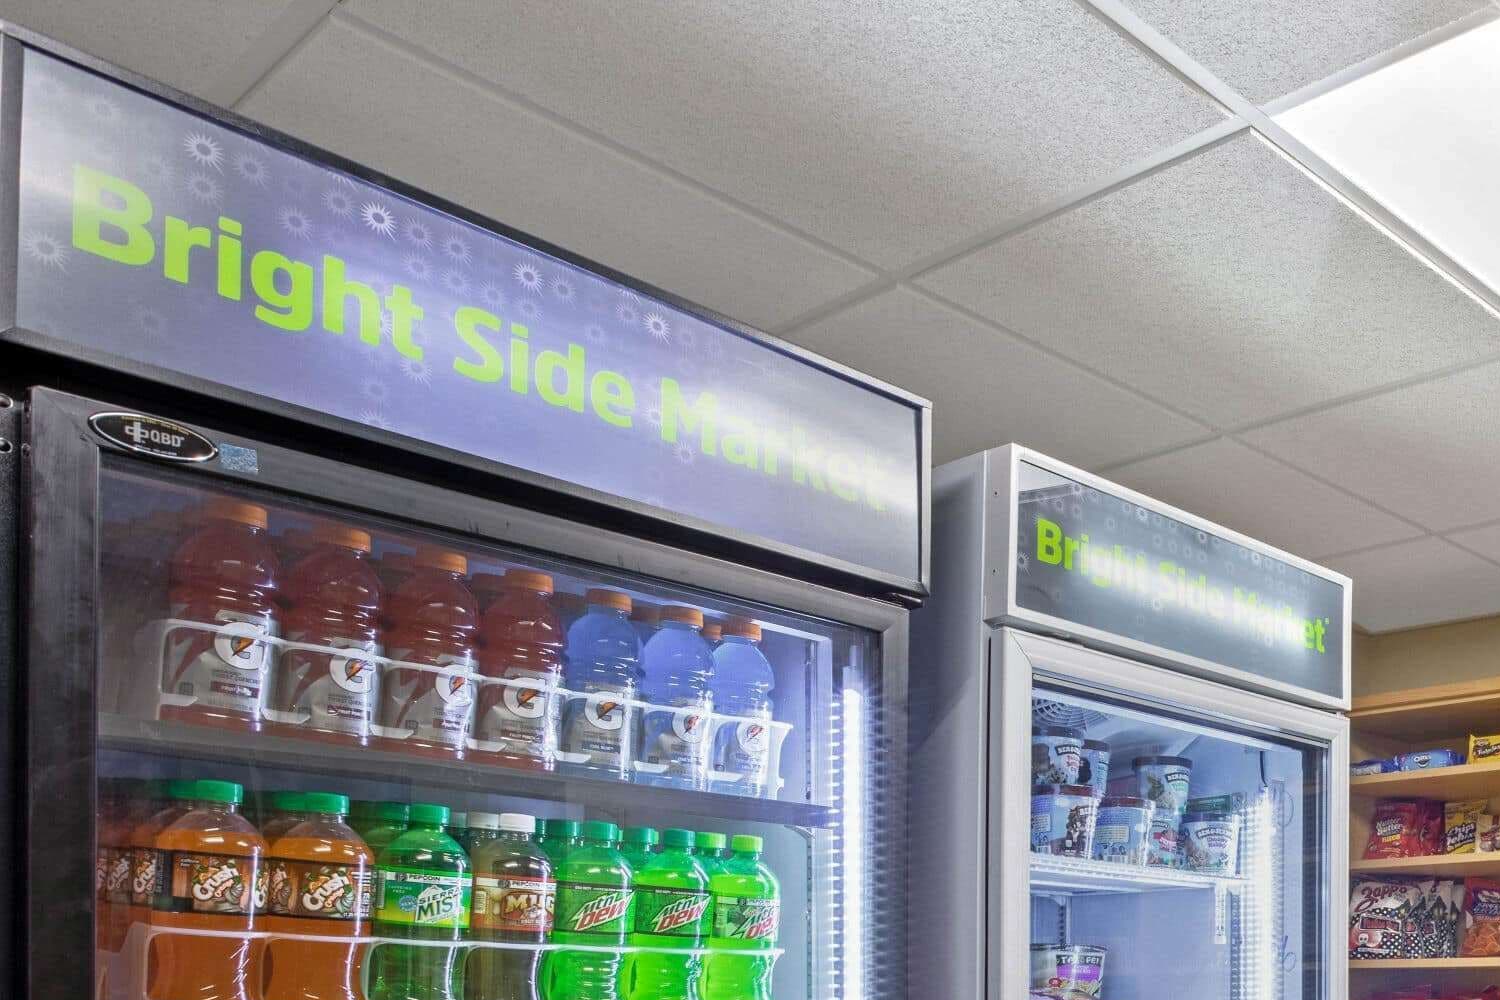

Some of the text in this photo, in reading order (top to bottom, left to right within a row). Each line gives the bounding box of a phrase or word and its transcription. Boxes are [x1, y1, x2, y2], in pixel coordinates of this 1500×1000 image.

[72, 164, 892, 512] Bright Side Market
[150, 430, 184, 447] QBD
[1036, 517, 1146, 588] Bright
[1159, 562, 1224, 618] Side
[506, 894, 556, 914] MUG
